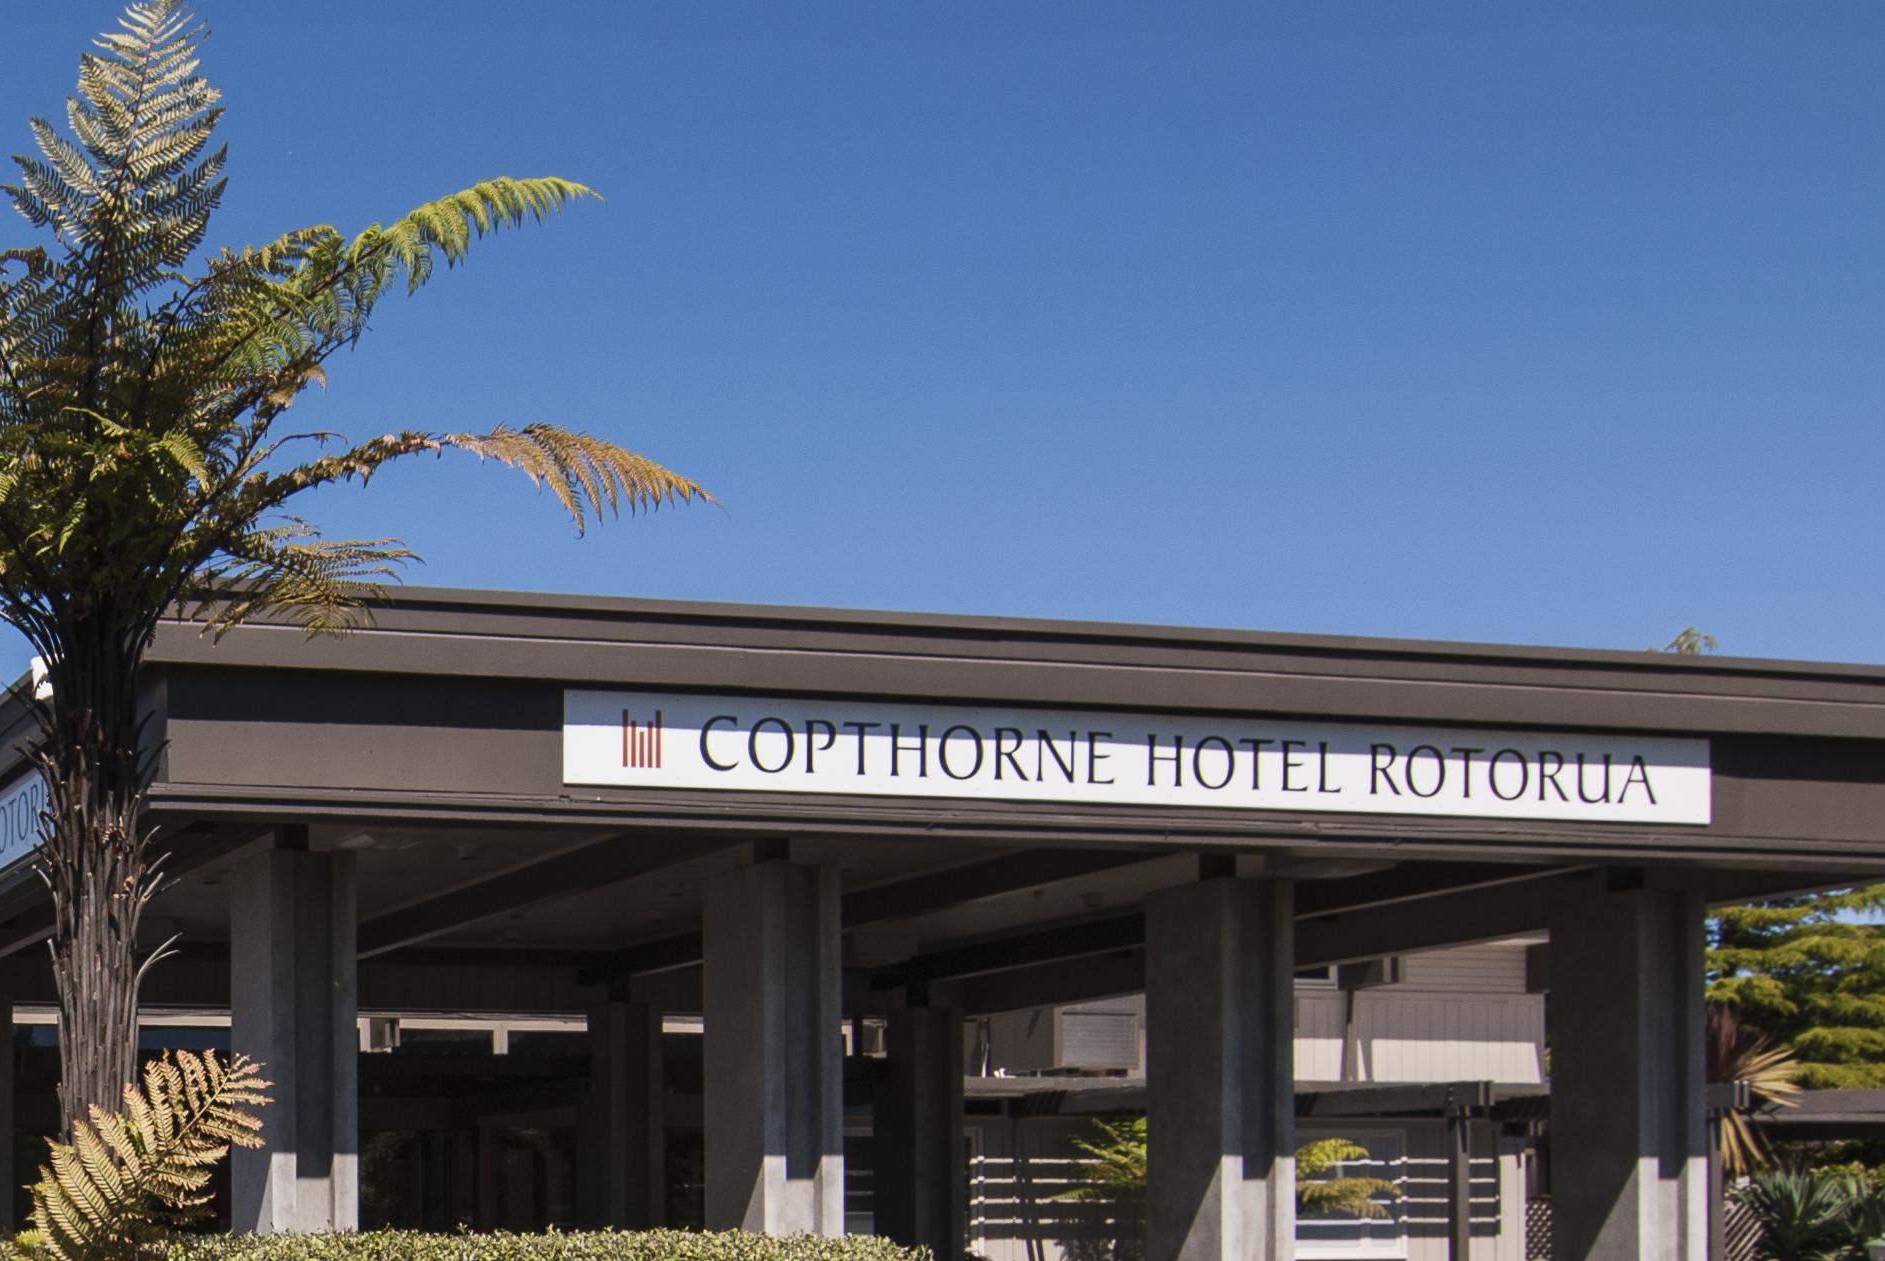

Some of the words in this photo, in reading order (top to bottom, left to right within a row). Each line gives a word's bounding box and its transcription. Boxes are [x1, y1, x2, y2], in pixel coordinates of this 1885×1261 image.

[699, 715, 1115, 785] COPTHORNE
[1146, 734, 1342, 794] HOTEL
[1370, 743, 1658, 806] ROTORUA
